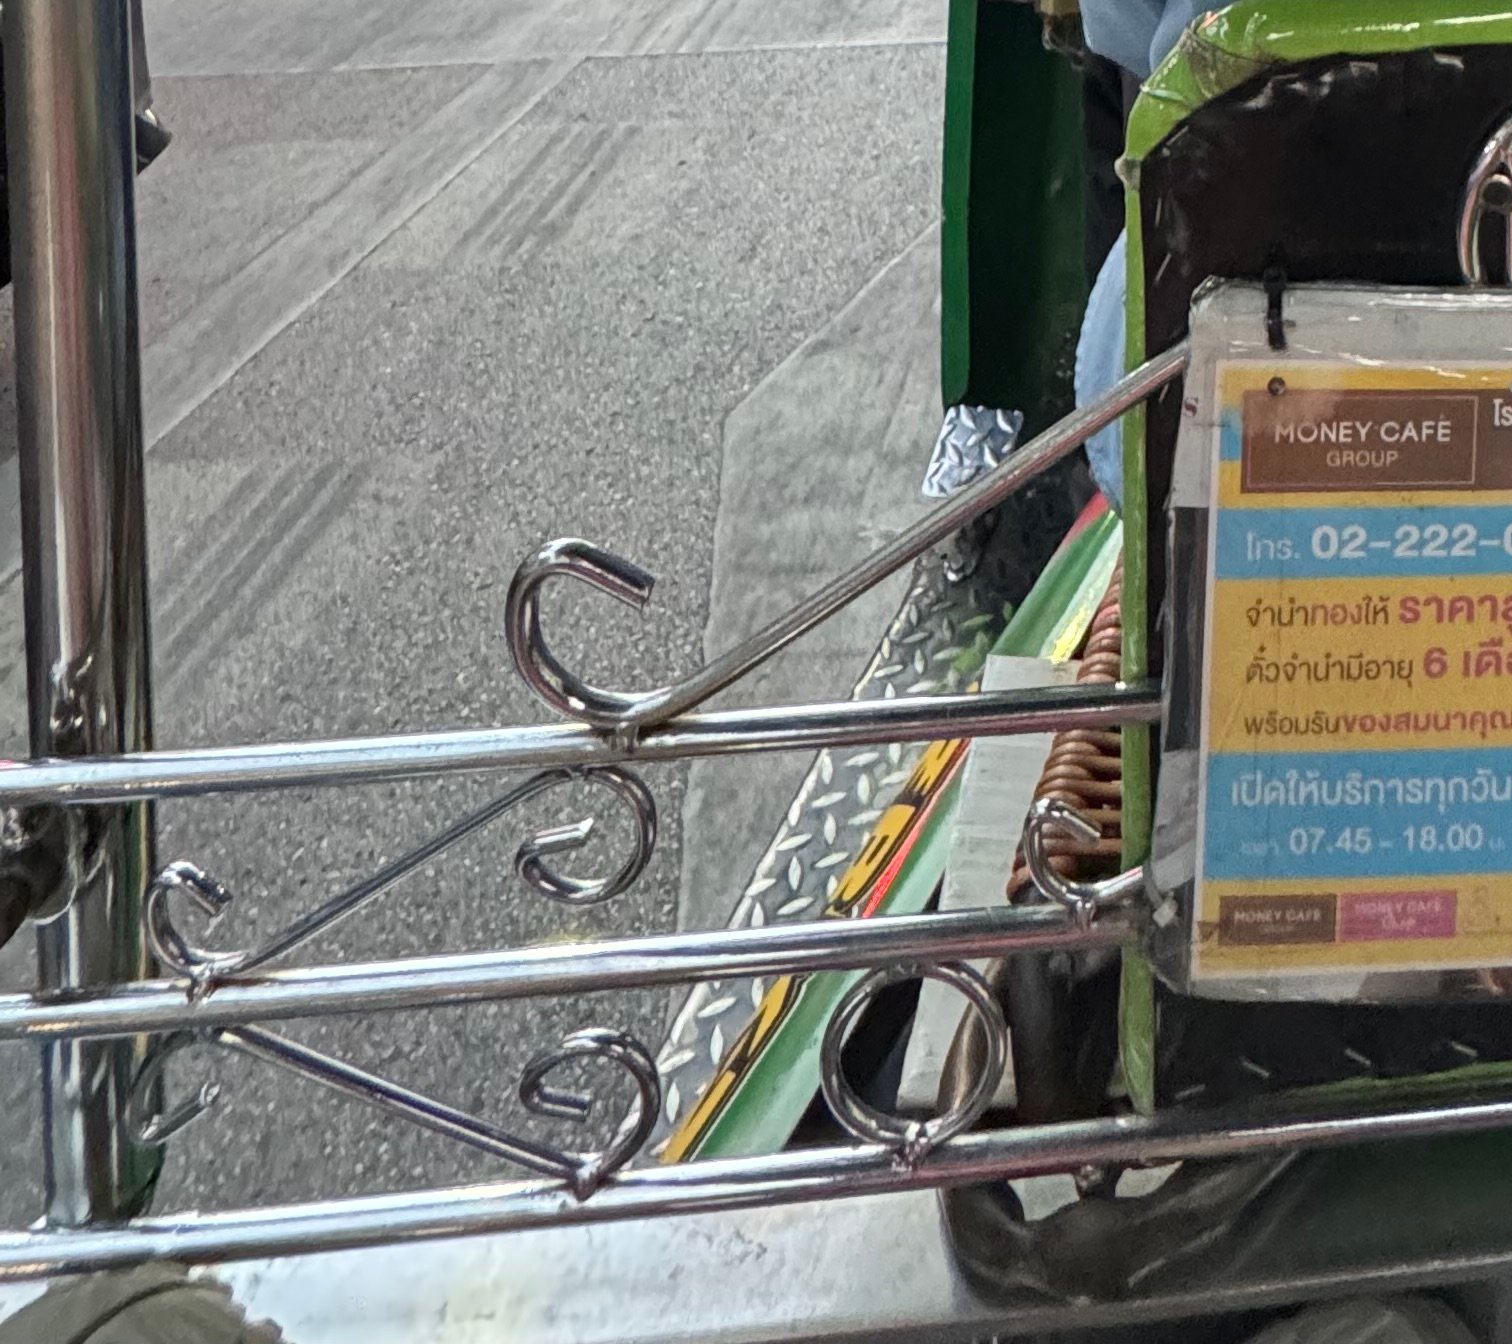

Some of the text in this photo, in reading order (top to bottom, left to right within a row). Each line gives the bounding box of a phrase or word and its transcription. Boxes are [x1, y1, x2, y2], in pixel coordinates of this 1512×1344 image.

[1275, 421, 1373, 444] MONEY
[1326, 450, 1399, 468] GROUP
[1246, 596, 1390, 628] จำนำทองให้
[1246, 645, 1414, 688] ตั๋วจำนำมีอายุ
[1423, 647, 1449, 679] 6
[1231, 767, 1512, 814] เปิดให้บริการทุกวัน
[1289, 826, 1372, 854] 07.45
[1404, 823, 1484, 852] 18.00
[1233, 910, 1282, 923] MONEY
